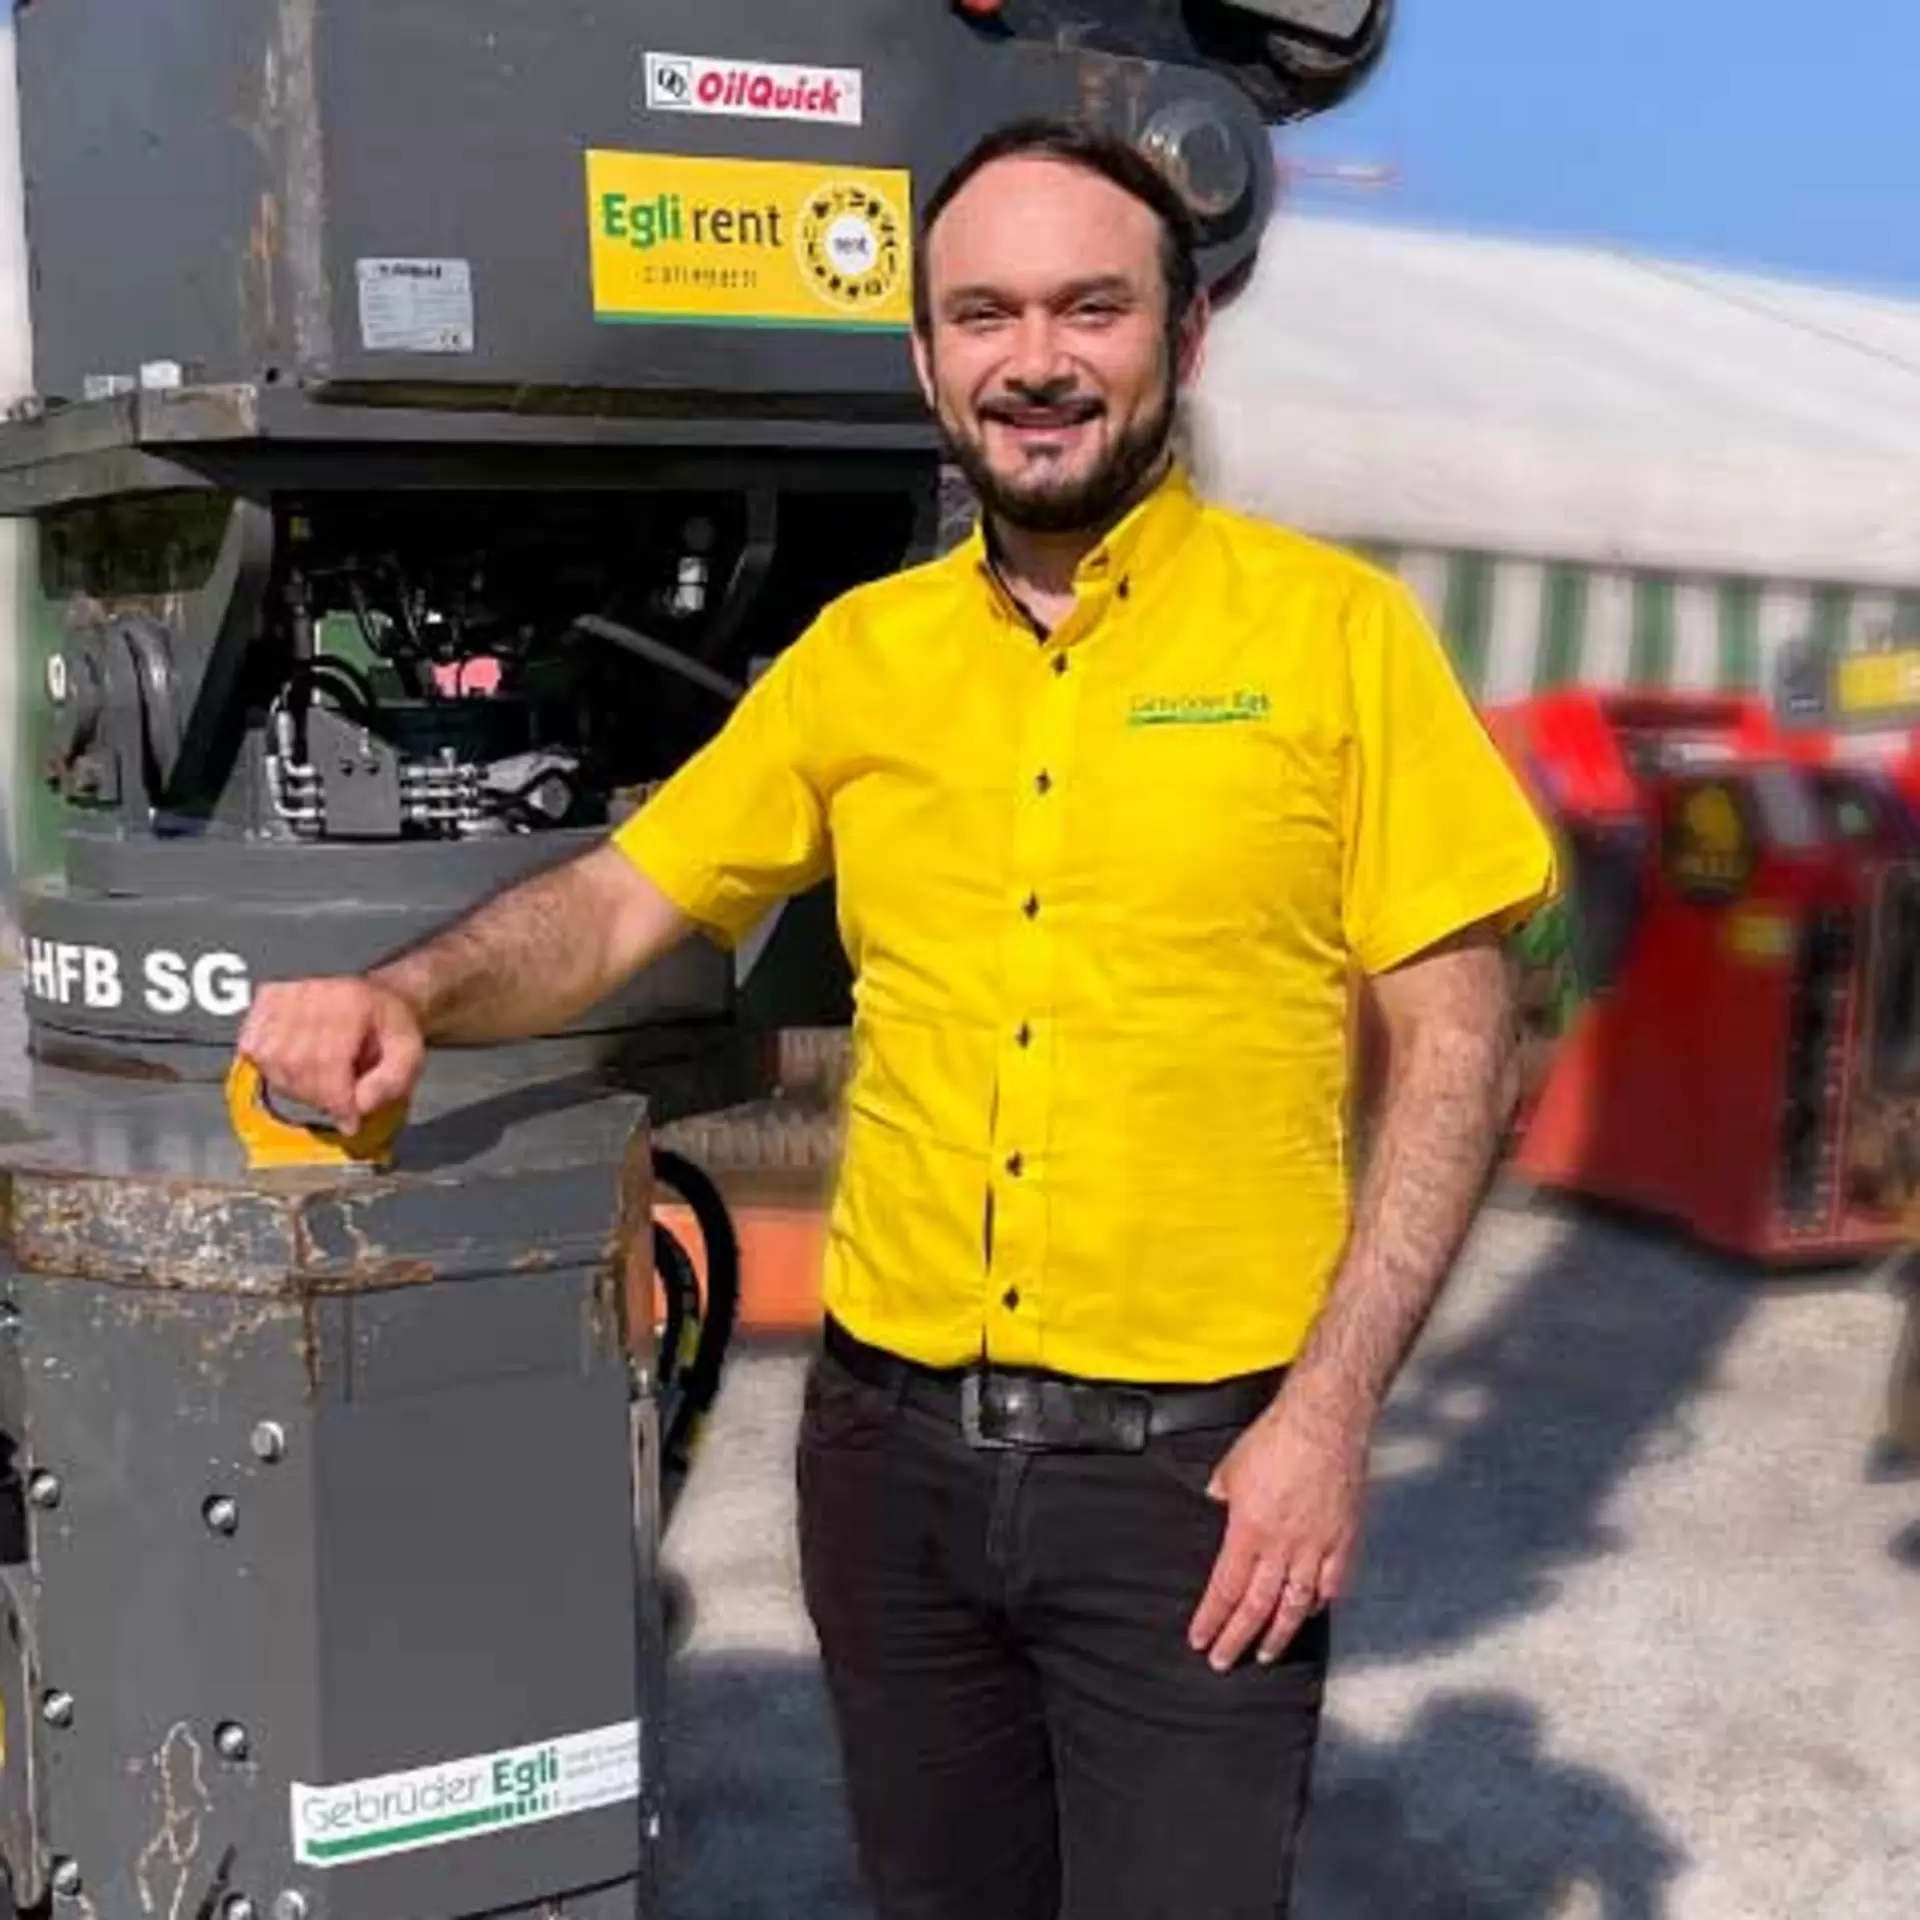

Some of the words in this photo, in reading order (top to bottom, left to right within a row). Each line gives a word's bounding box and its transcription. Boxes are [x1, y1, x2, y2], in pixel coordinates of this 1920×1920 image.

[697, 72, 842, 114] OilQuick
[601, 193, 682, 248] Egli
[693, 205, 783, 247] rent
[20, 936, 123, 1008] HFB
[144, 951, 250, 1016] SG
[491, 1746, 558, 1796] Egli
